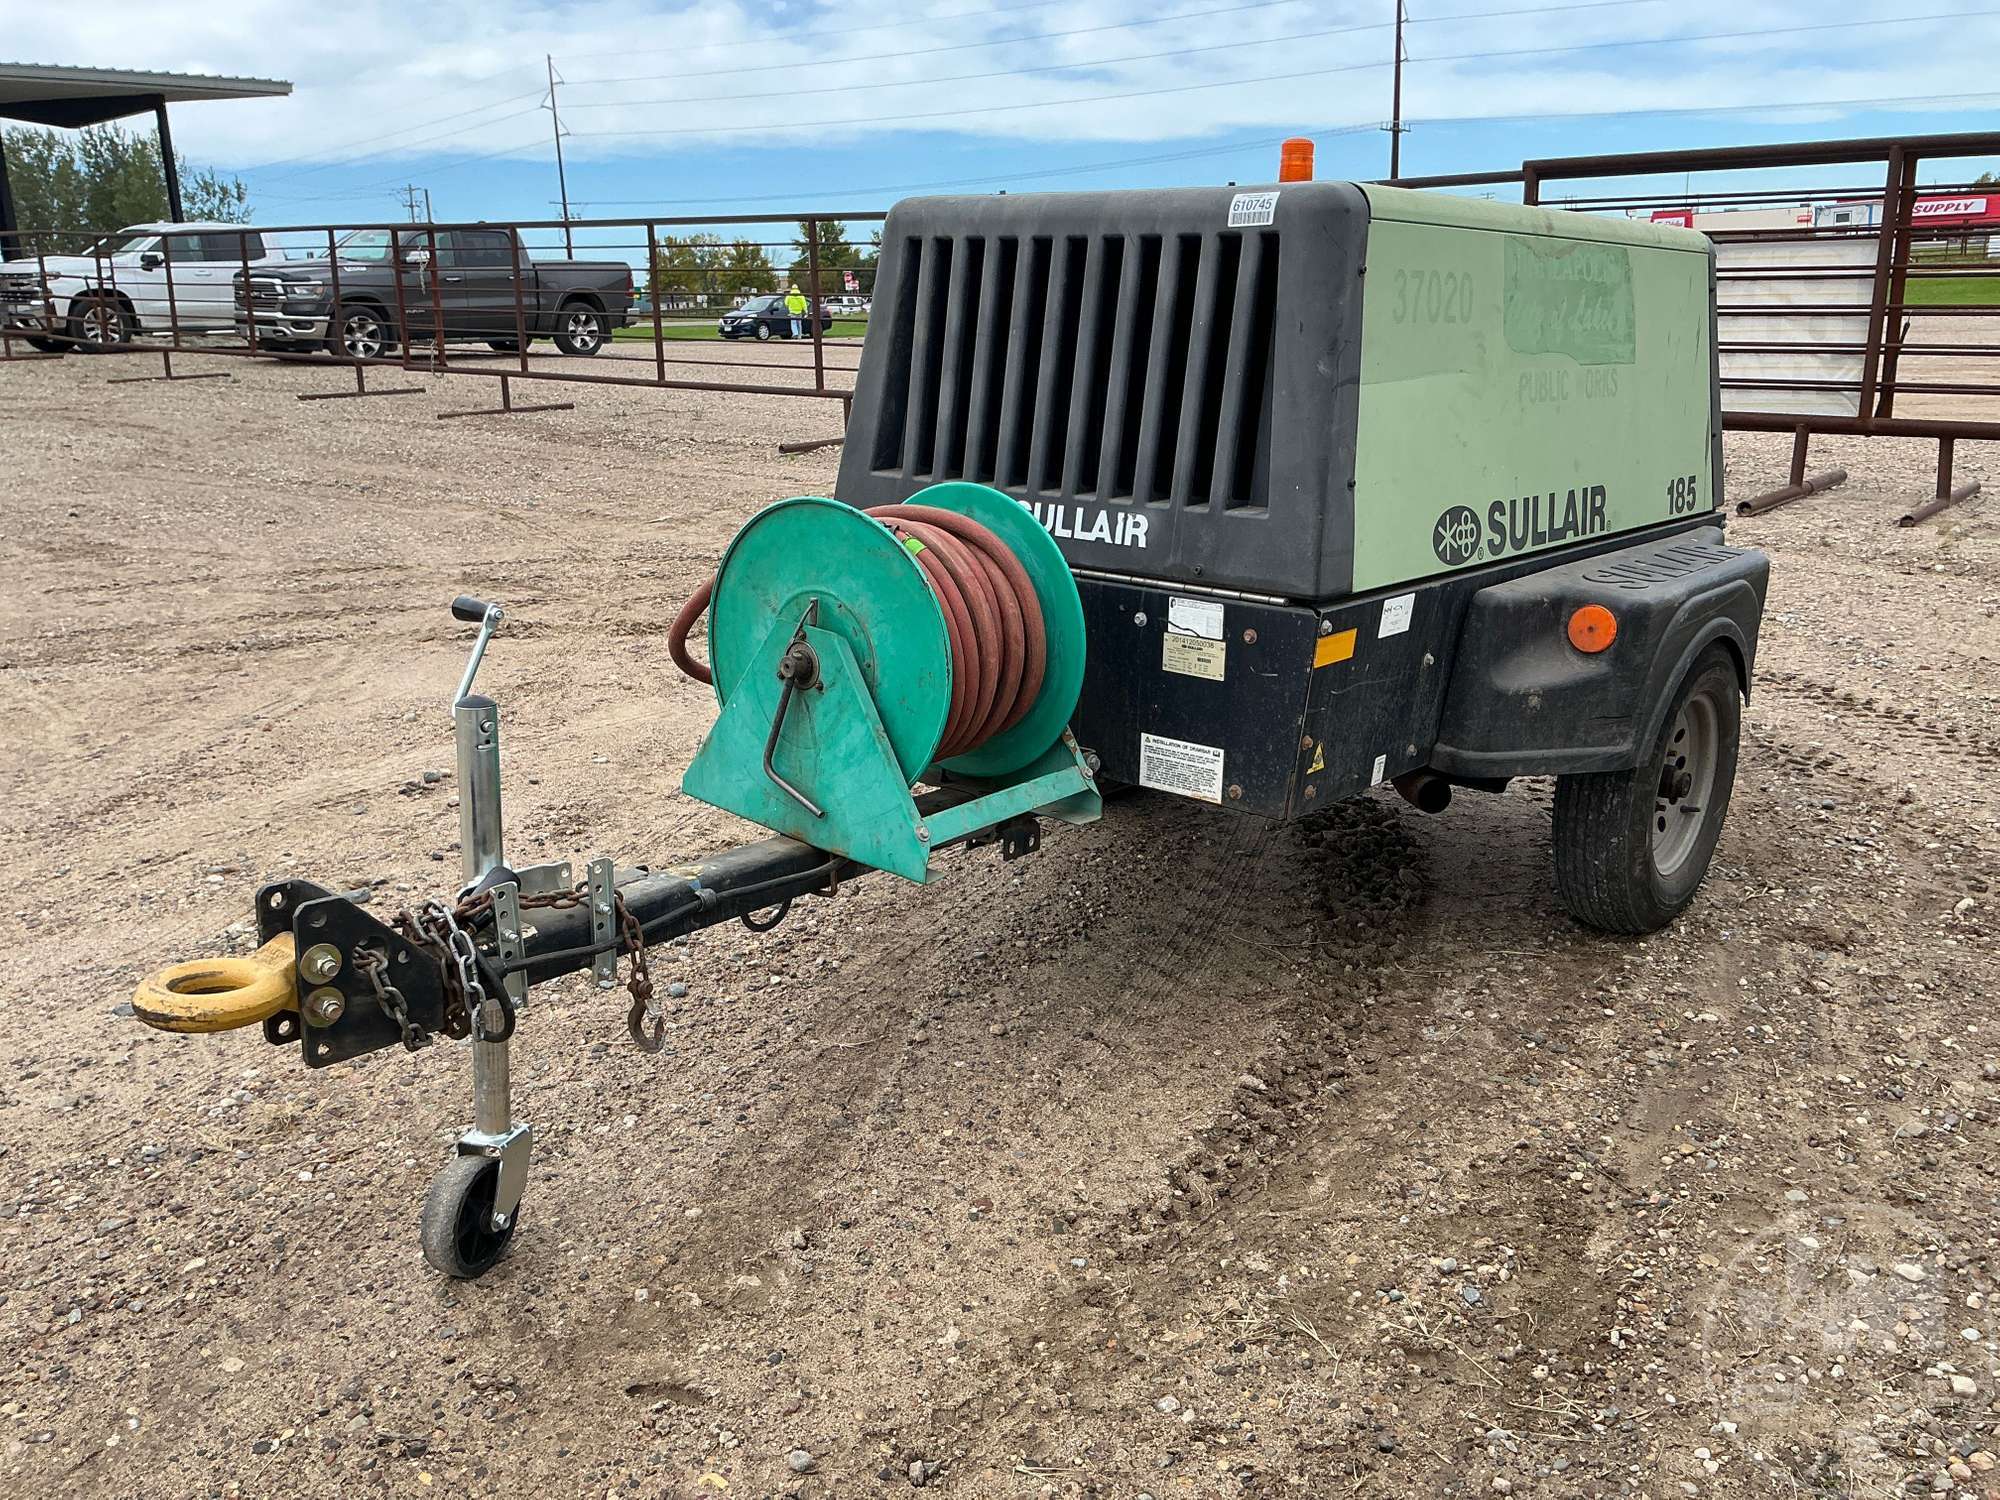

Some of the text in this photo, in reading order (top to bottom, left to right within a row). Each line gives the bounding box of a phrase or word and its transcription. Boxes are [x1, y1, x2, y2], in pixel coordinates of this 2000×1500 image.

[1232, 198, 1273, 211] 610745
[1911, 201, 1976, 214] SUPPLY
[1391, 268, 1474, 324] 37020
[1518, 369, 1569, 404] PUBLIC
[1666, 474, 1697, 515] 185
[1017, 500, 1149, 548] ULLAIR
[1486, 484, 1608, 557] SULLAIR
